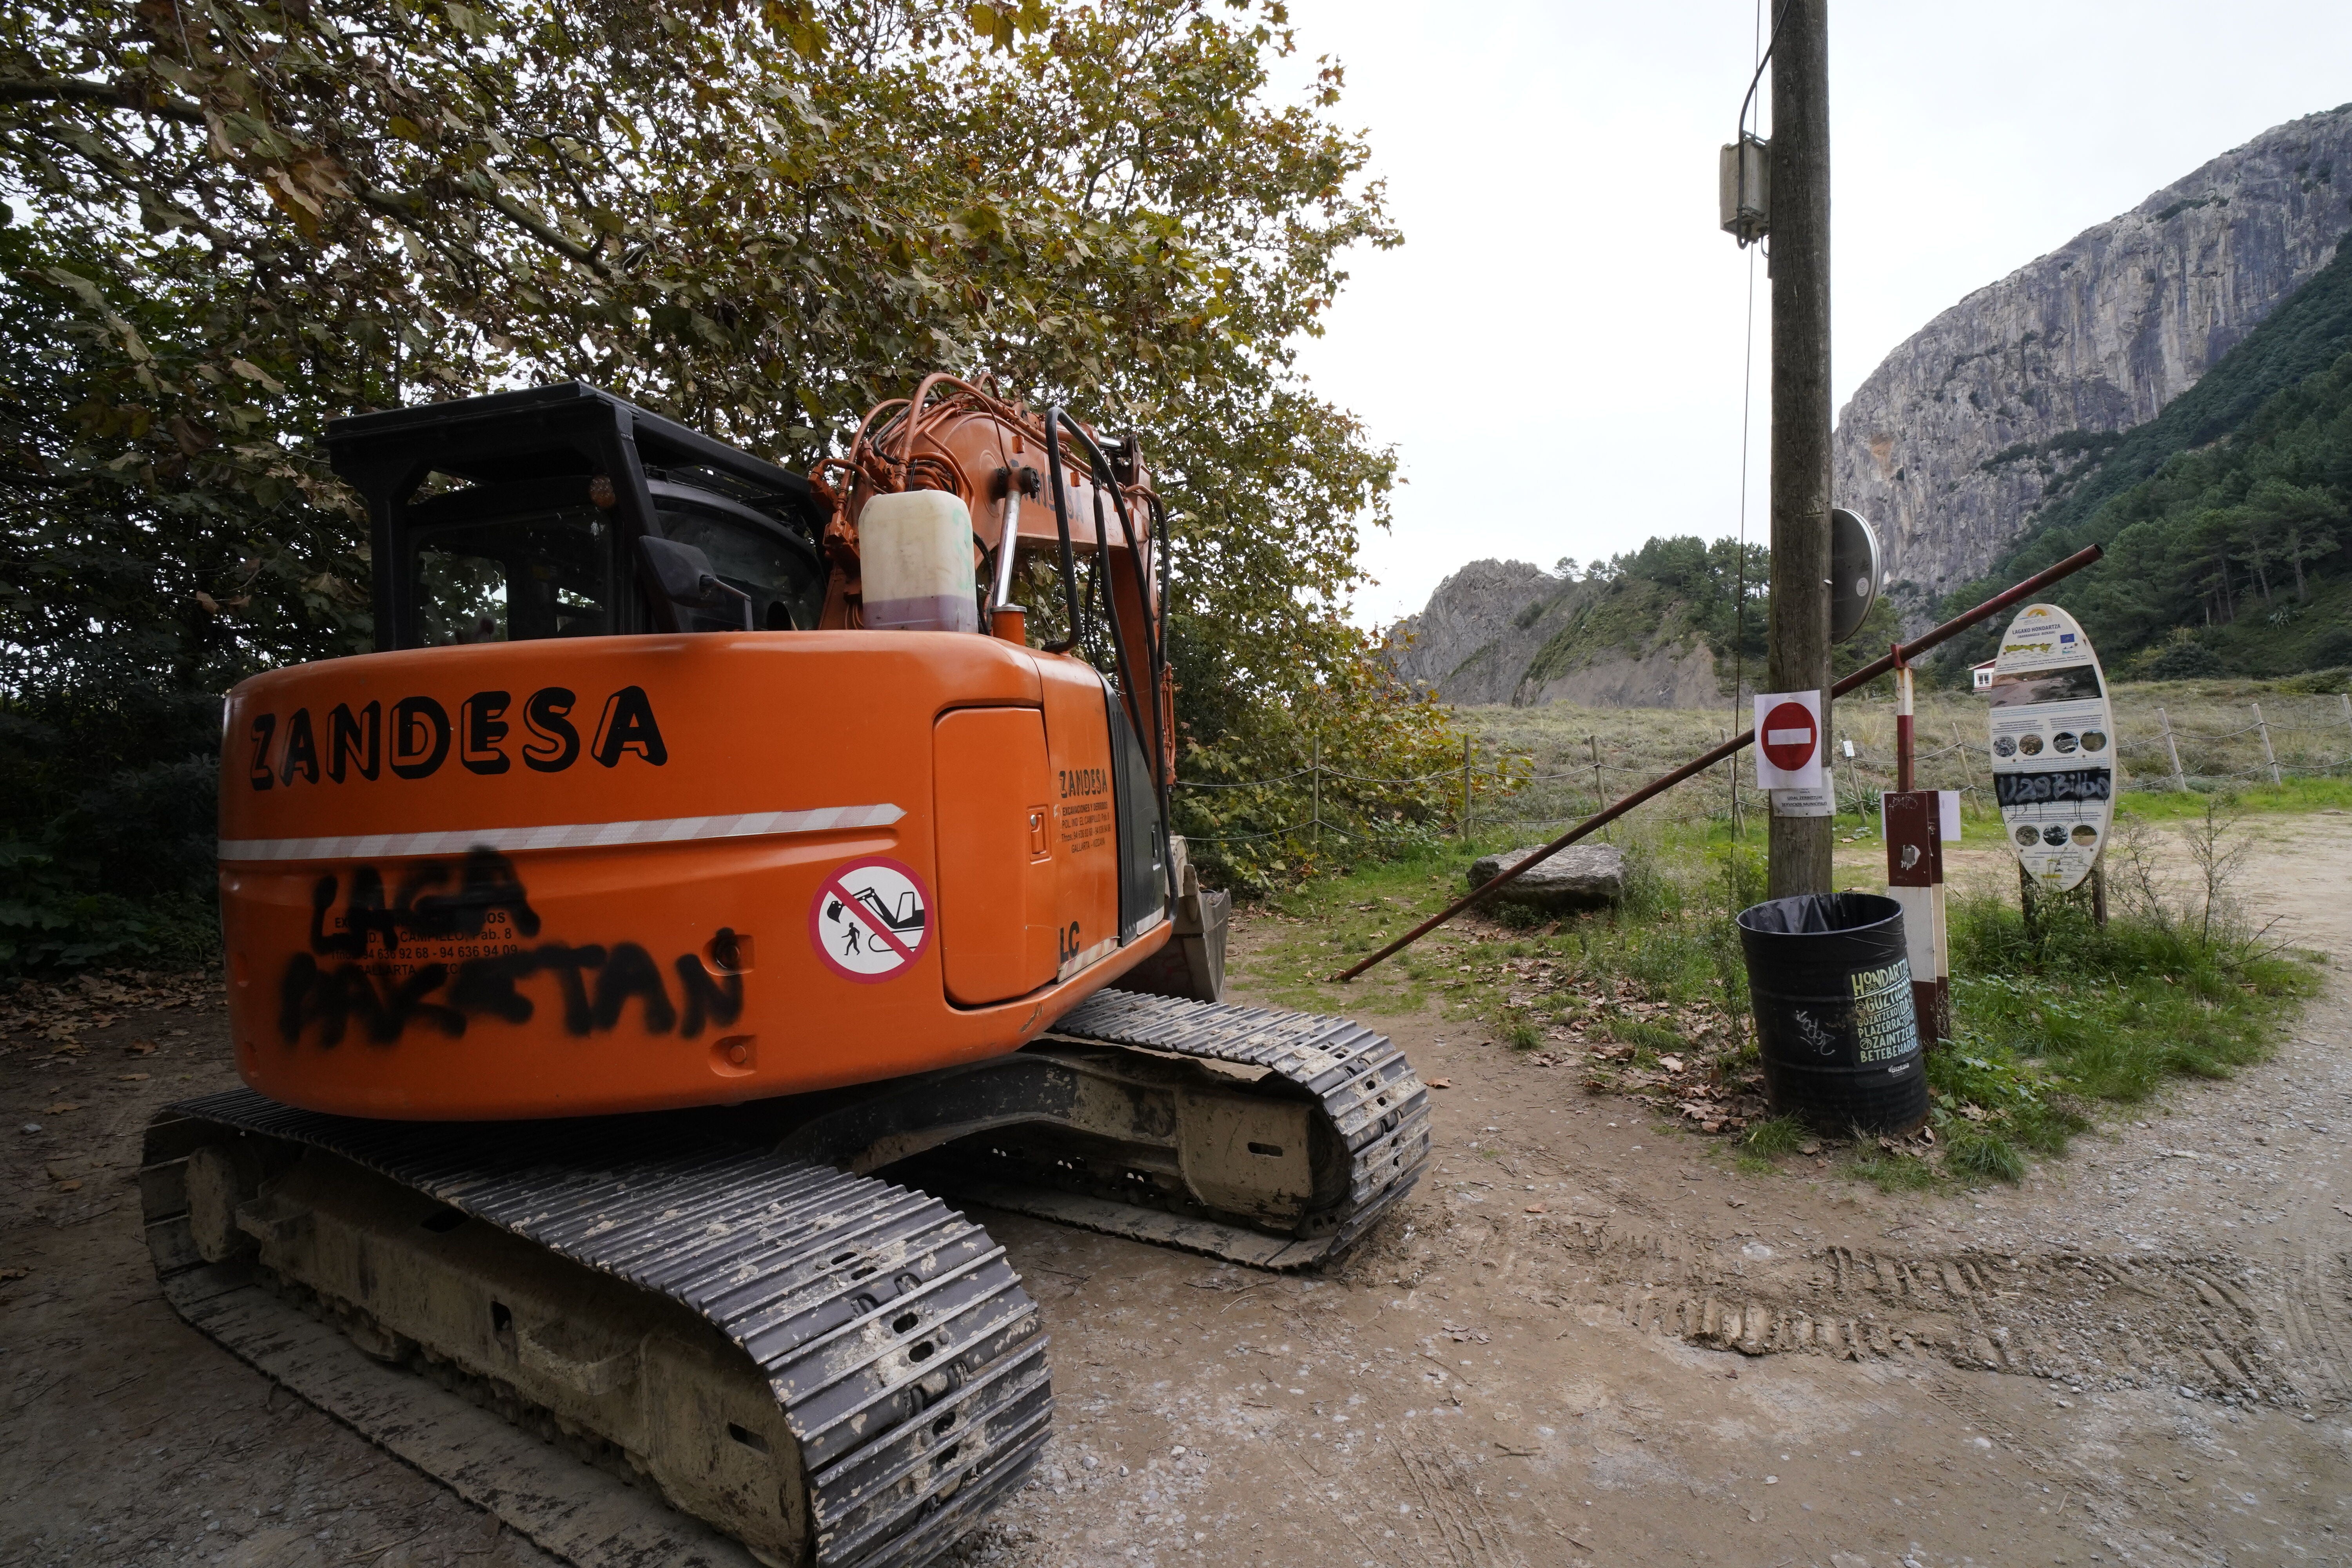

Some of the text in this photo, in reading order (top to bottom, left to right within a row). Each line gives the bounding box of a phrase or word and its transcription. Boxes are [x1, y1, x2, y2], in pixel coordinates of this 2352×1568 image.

[250, 685, 668, 791] ZANDESA
[1059, 768, 1107, 799] ZANDESA
[1062, 804, 1090, 816] EXCAVACIONES
[1071, 841, 1090, 853] GALLARTA
[505, 927, 512, 939] 8
[1060, 920, 1080, 964] LC
[377, 948, 396, 959] 636
[399, 947, 412, 959] 92
[416, 947, 428, 958] 68
[440, 946, 454, 958] 94
[458, 946, 479, 957] 636
[483, 945, 498, 956] 94
[503, 944, 518, 956] 09
[1899, 997, 1910, 1016] DA
[1857, 1007, 1898, 1027] GOZATZEKO
[1872, 1023, 1915, 1049] ZAINTZEKO
[1860, 1036, 1918, 1063] BETEBEHARRA
[1891, 1062, 1909, 1073] Bizkaia
